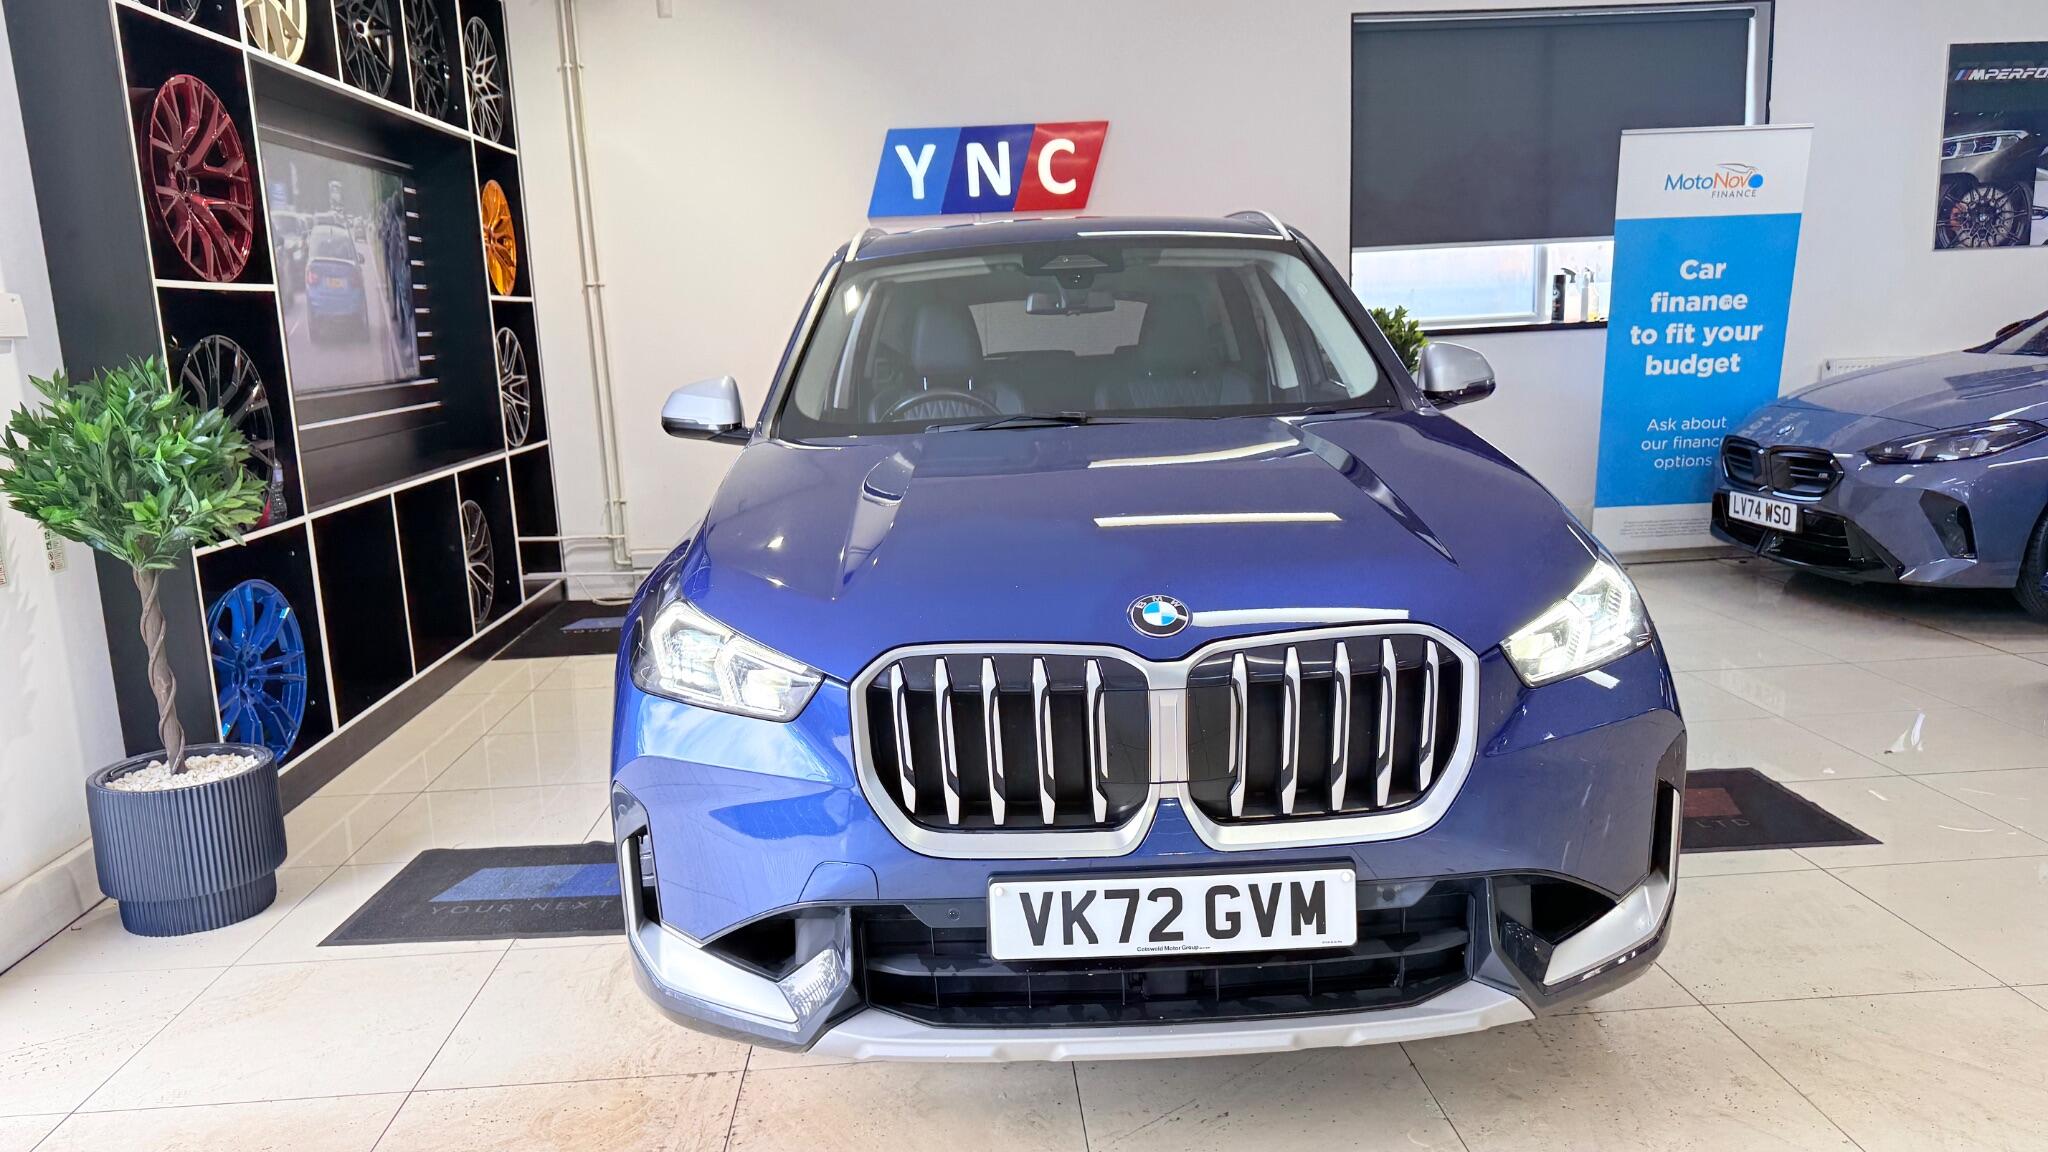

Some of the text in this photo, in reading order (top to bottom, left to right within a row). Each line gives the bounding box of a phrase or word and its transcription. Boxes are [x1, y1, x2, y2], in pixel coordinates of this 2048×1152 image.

[1968, 67, 2048, 81] MPERFO
[895, 138, 1077, 200] YNC
[1711, 189, 1757, 198] FINANCE
[1680, 259, 1727, 280] Car
[1650, 291, 1748, 313] finance
[1630, 323, 1763, 347] to fit your
[1645, 353, 1741, 378] budget
[1647, 416, 1727, 432] Ask about
[1641, 436, 1719, 451] our financ
[1654, 455, 1713, 470] options
[1733, 494, 1791, 526] LV74 WSO
[430, 900, 613, 915] YOUR NEXT
[1019, 880, 1327, 947] VK72 GVM
